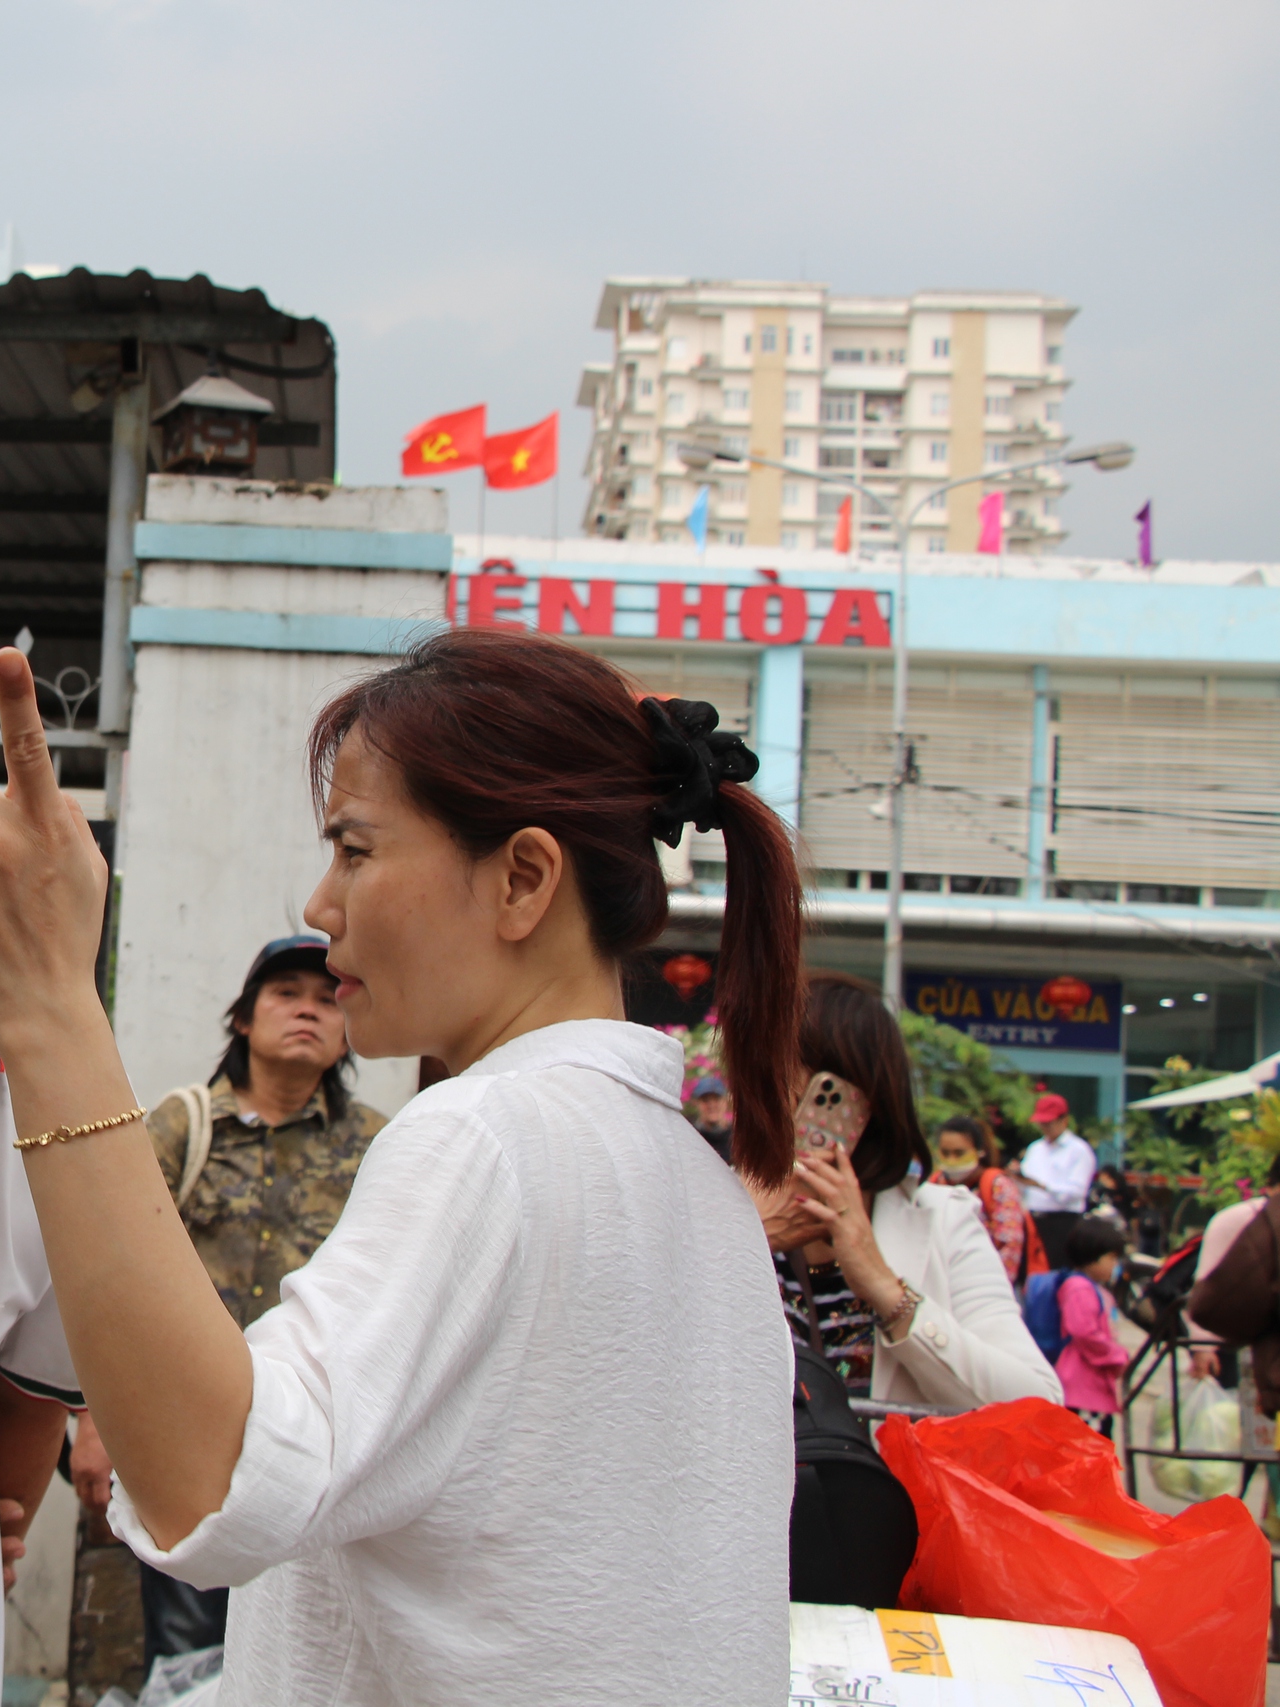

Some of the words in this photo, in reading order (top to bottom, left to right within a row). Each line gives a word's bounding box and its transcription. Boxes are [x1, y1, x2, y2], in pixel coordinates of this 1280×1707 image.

[657, 568, 891, 648] HÒA
[917, 977, 982, 1017] CỬA
[992, 983, 1056, 1022] VÀO
[969, 1022, 1059, 1044] ENTRY
